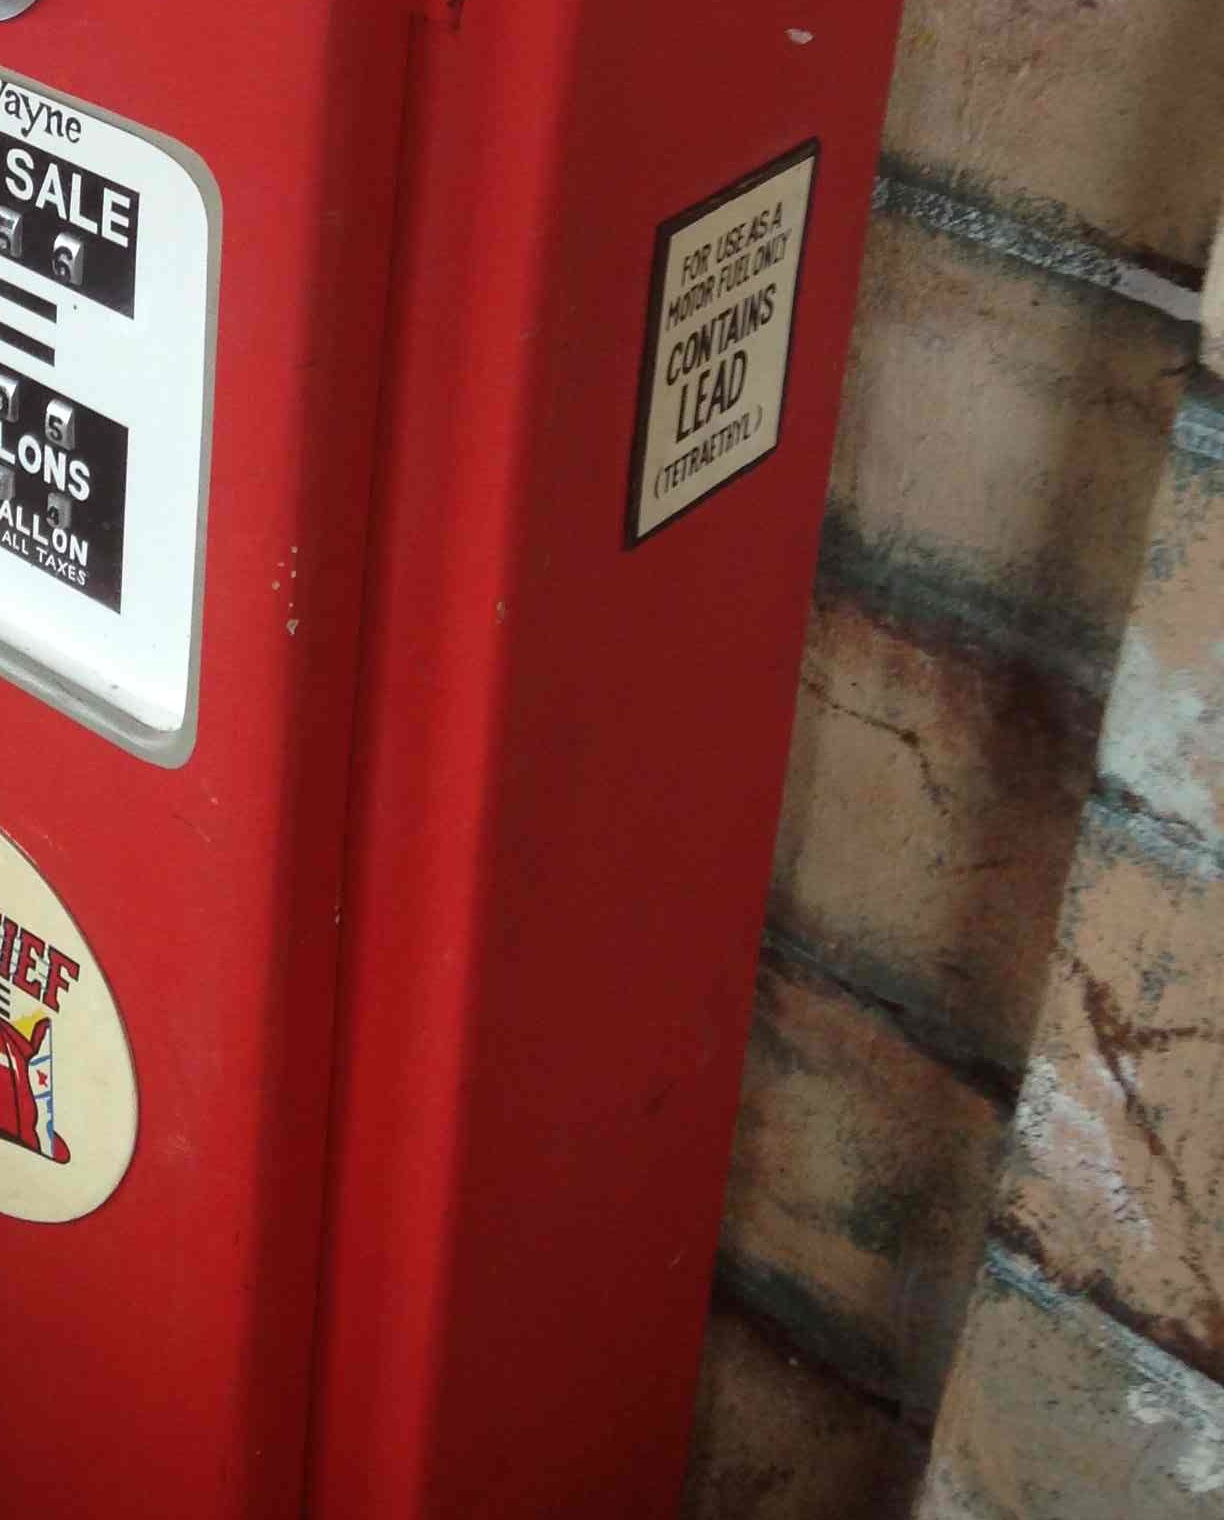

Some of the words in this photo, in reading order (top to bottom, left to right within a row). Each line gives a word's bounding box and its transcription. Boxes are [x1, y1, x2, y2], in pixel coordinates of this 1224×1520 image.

[4, 147, 132, 249] SALE
[665, 274, 716, 332] MOTOR
[718, 252, 752, 299] FUEL
[753, 227, 793, 276] ONLY
[681, 242, 712, 287] FOR
[717, 221, 747, 264] USE
[666, 282, 777, 387] CONTAINS
[675, 349, 749, 445] LEAD
[1, 530, 29, 556] ALL
[35, 546, 88, 586] TAXES
